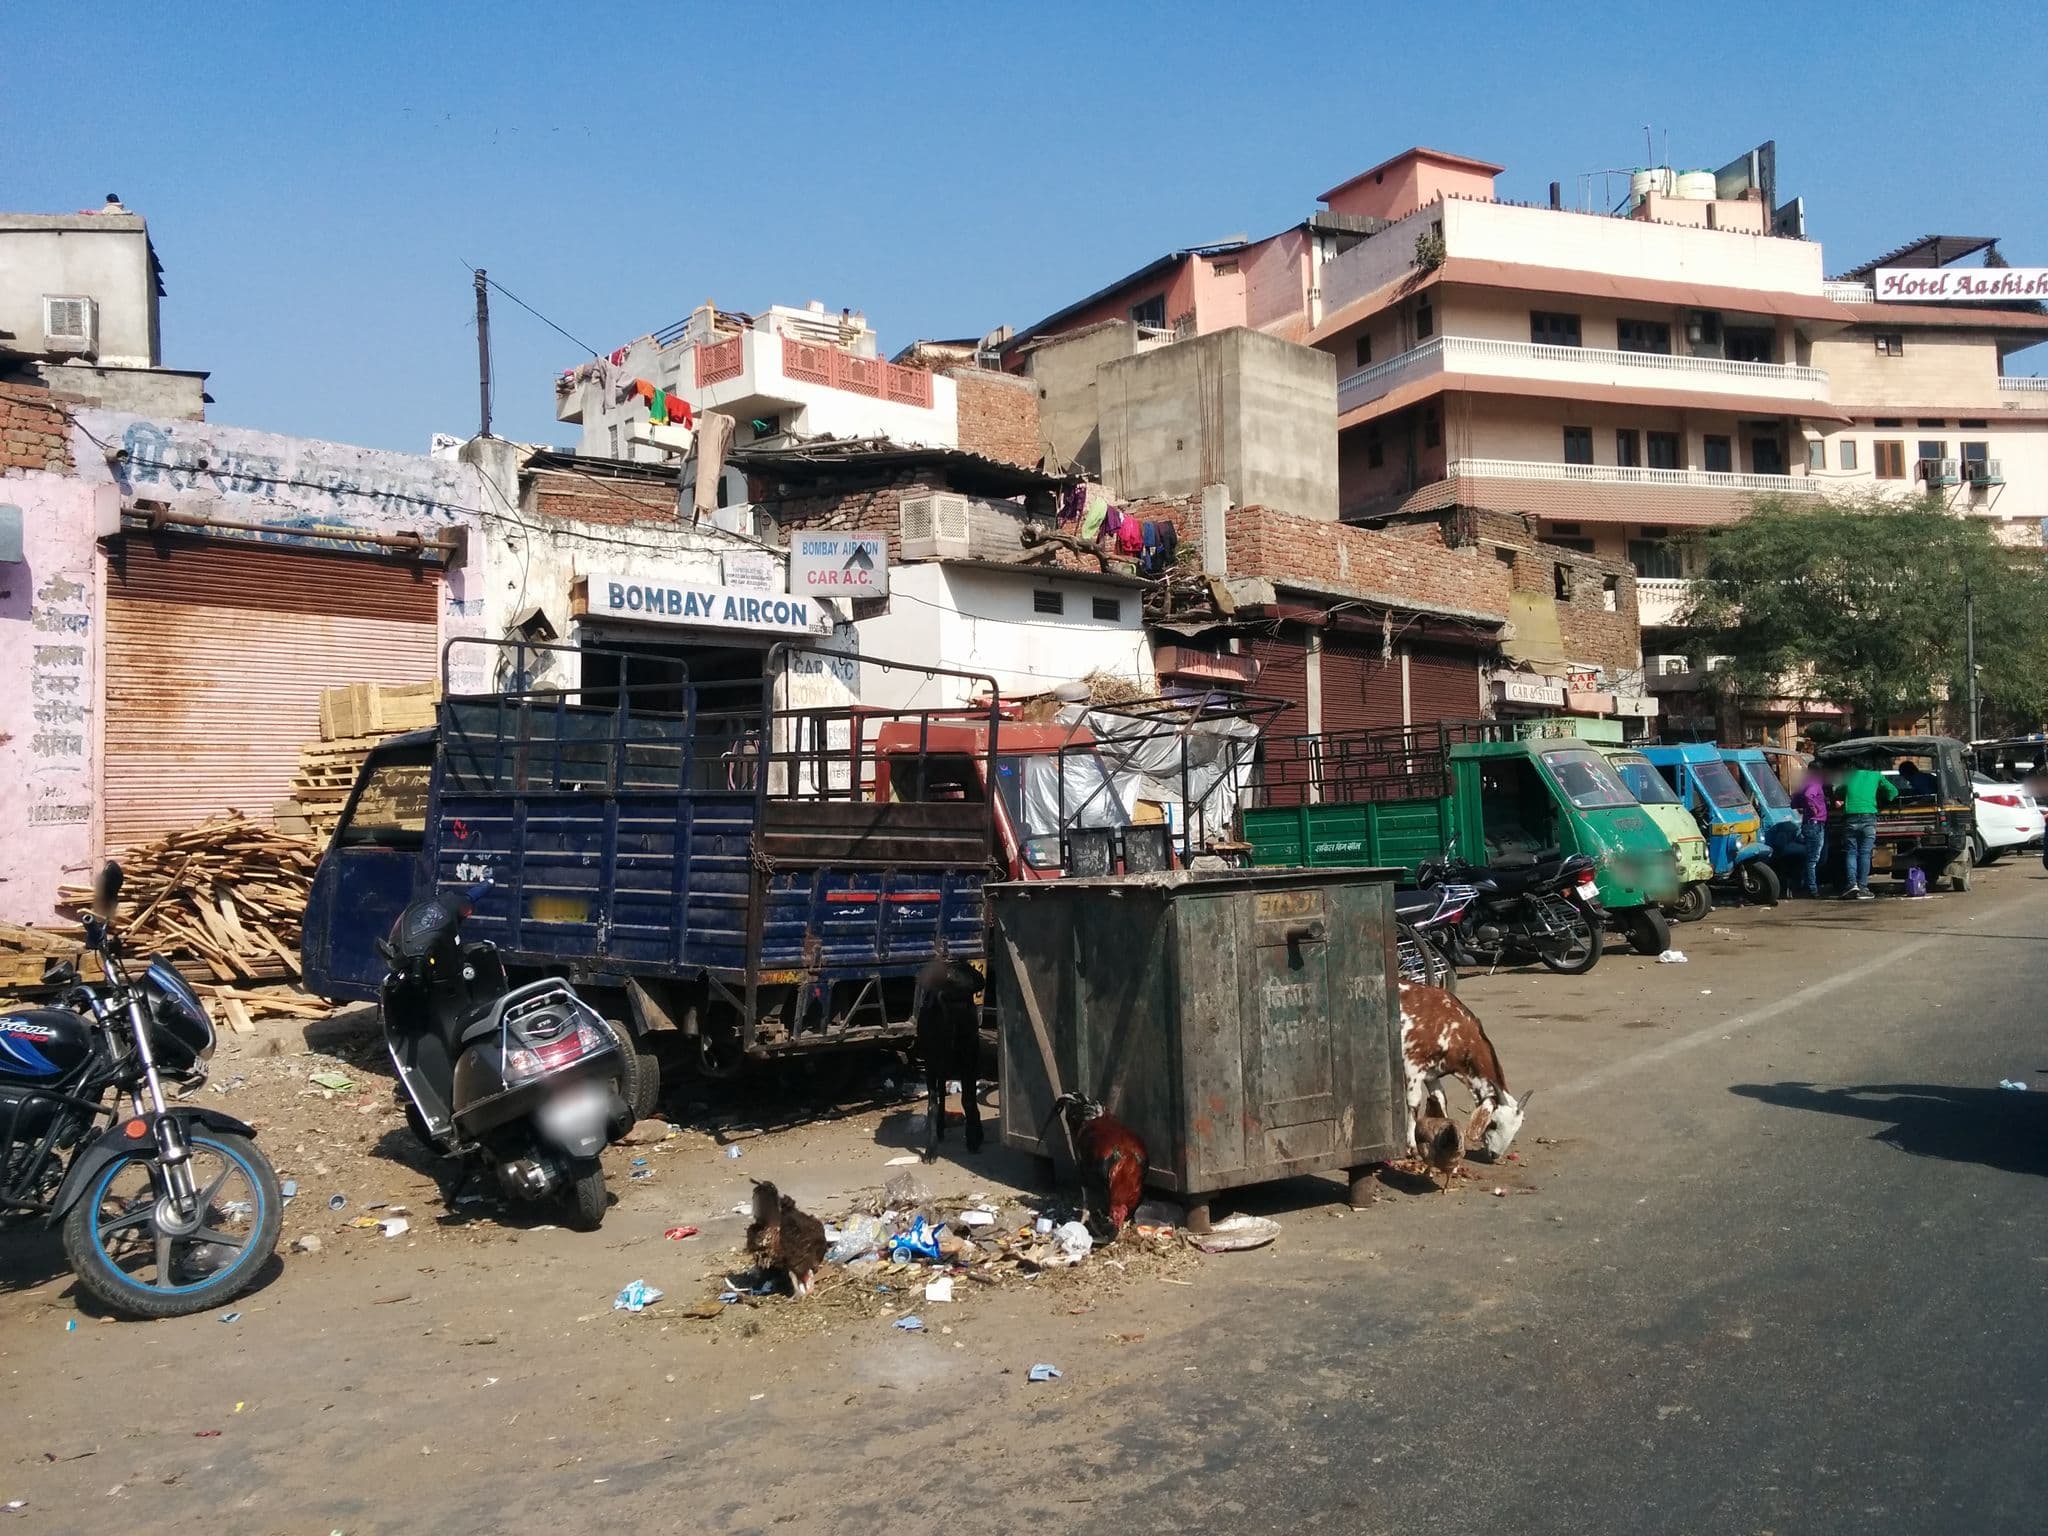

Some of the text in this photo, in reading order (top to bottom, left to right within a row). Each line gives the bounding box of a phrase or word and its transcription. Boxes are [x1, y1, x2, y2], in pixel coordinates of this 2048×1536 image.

[1882, 273, 2048, 296] Hotel Aashish
[802, 541, 839, 556] BOMBAY
[807, 570, 873, 585] CAR A.C.
[608, 582, 807, 626] BOMBAY AIRCON
[1567, 672, 1596, 682] CAR
[1511, 684, 1528, 698] CAR
